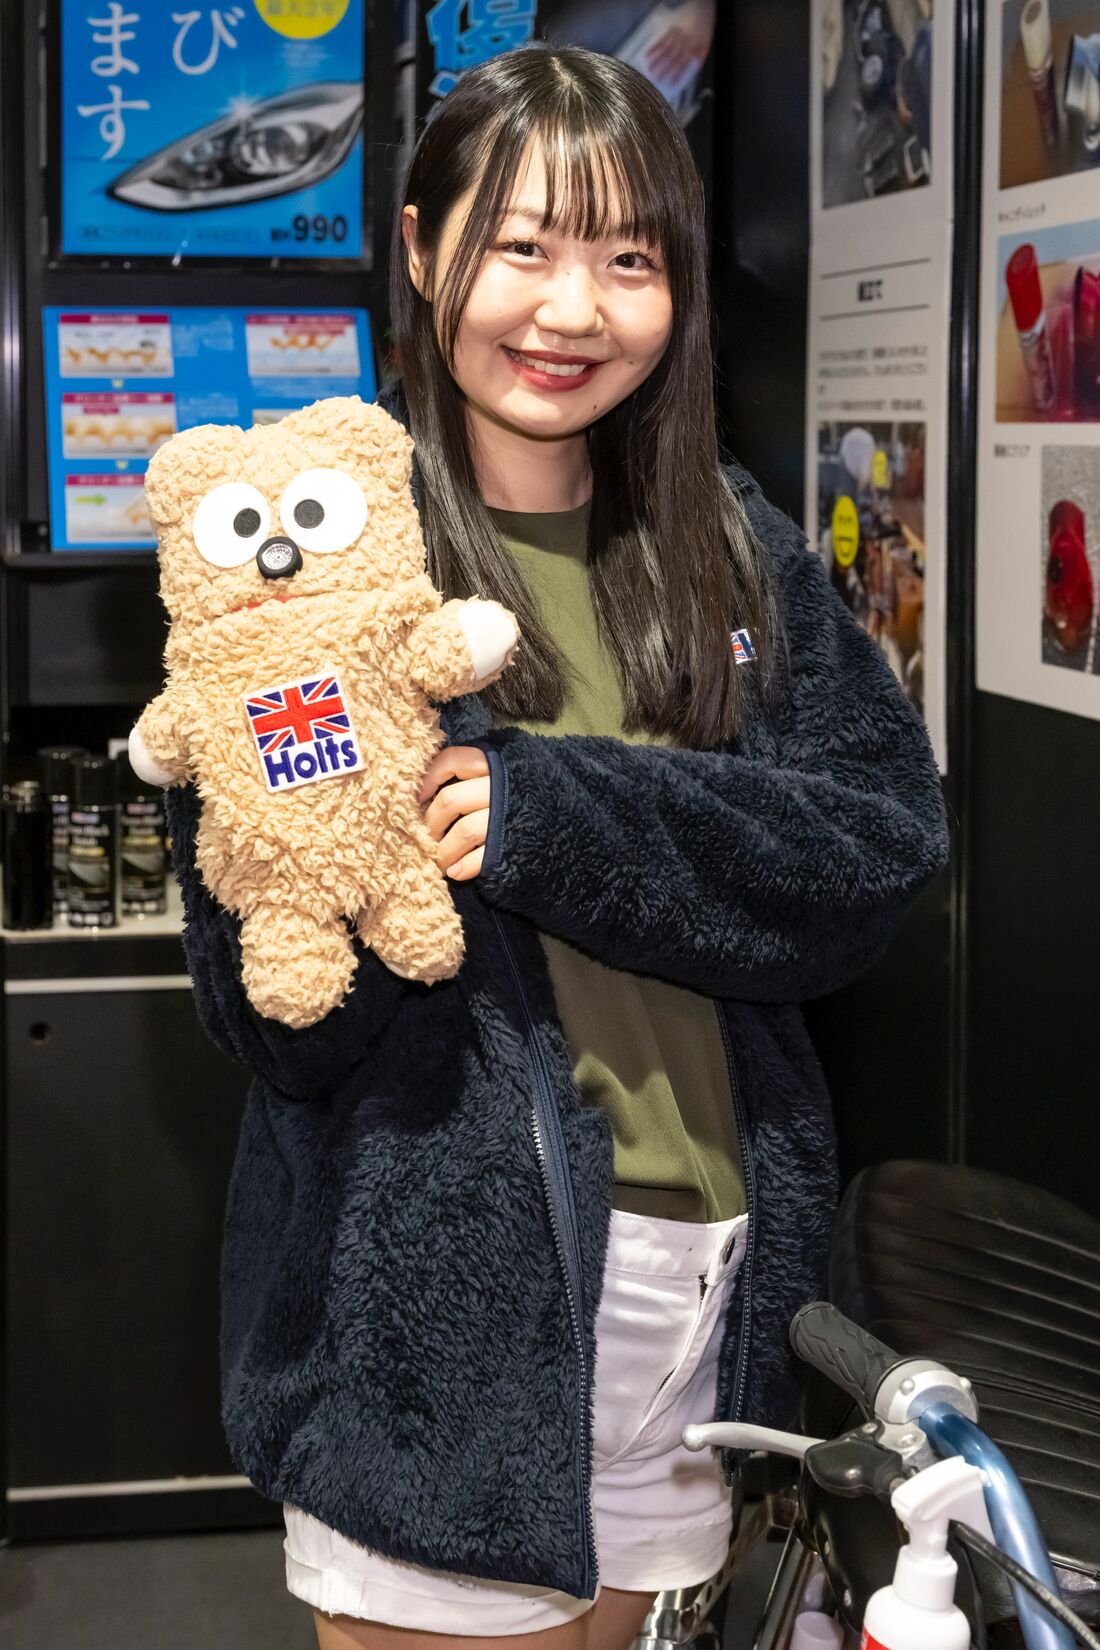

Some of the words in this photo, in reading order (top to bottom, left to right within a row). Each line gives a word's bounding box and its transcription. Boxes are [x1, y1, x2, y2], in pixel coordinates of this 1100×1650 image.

[171, 6, 246, 76] び
[76, 2, 151, 161] ます
[293, 214, 348, 242] 990
[263, 738, 358, 787] Holts
